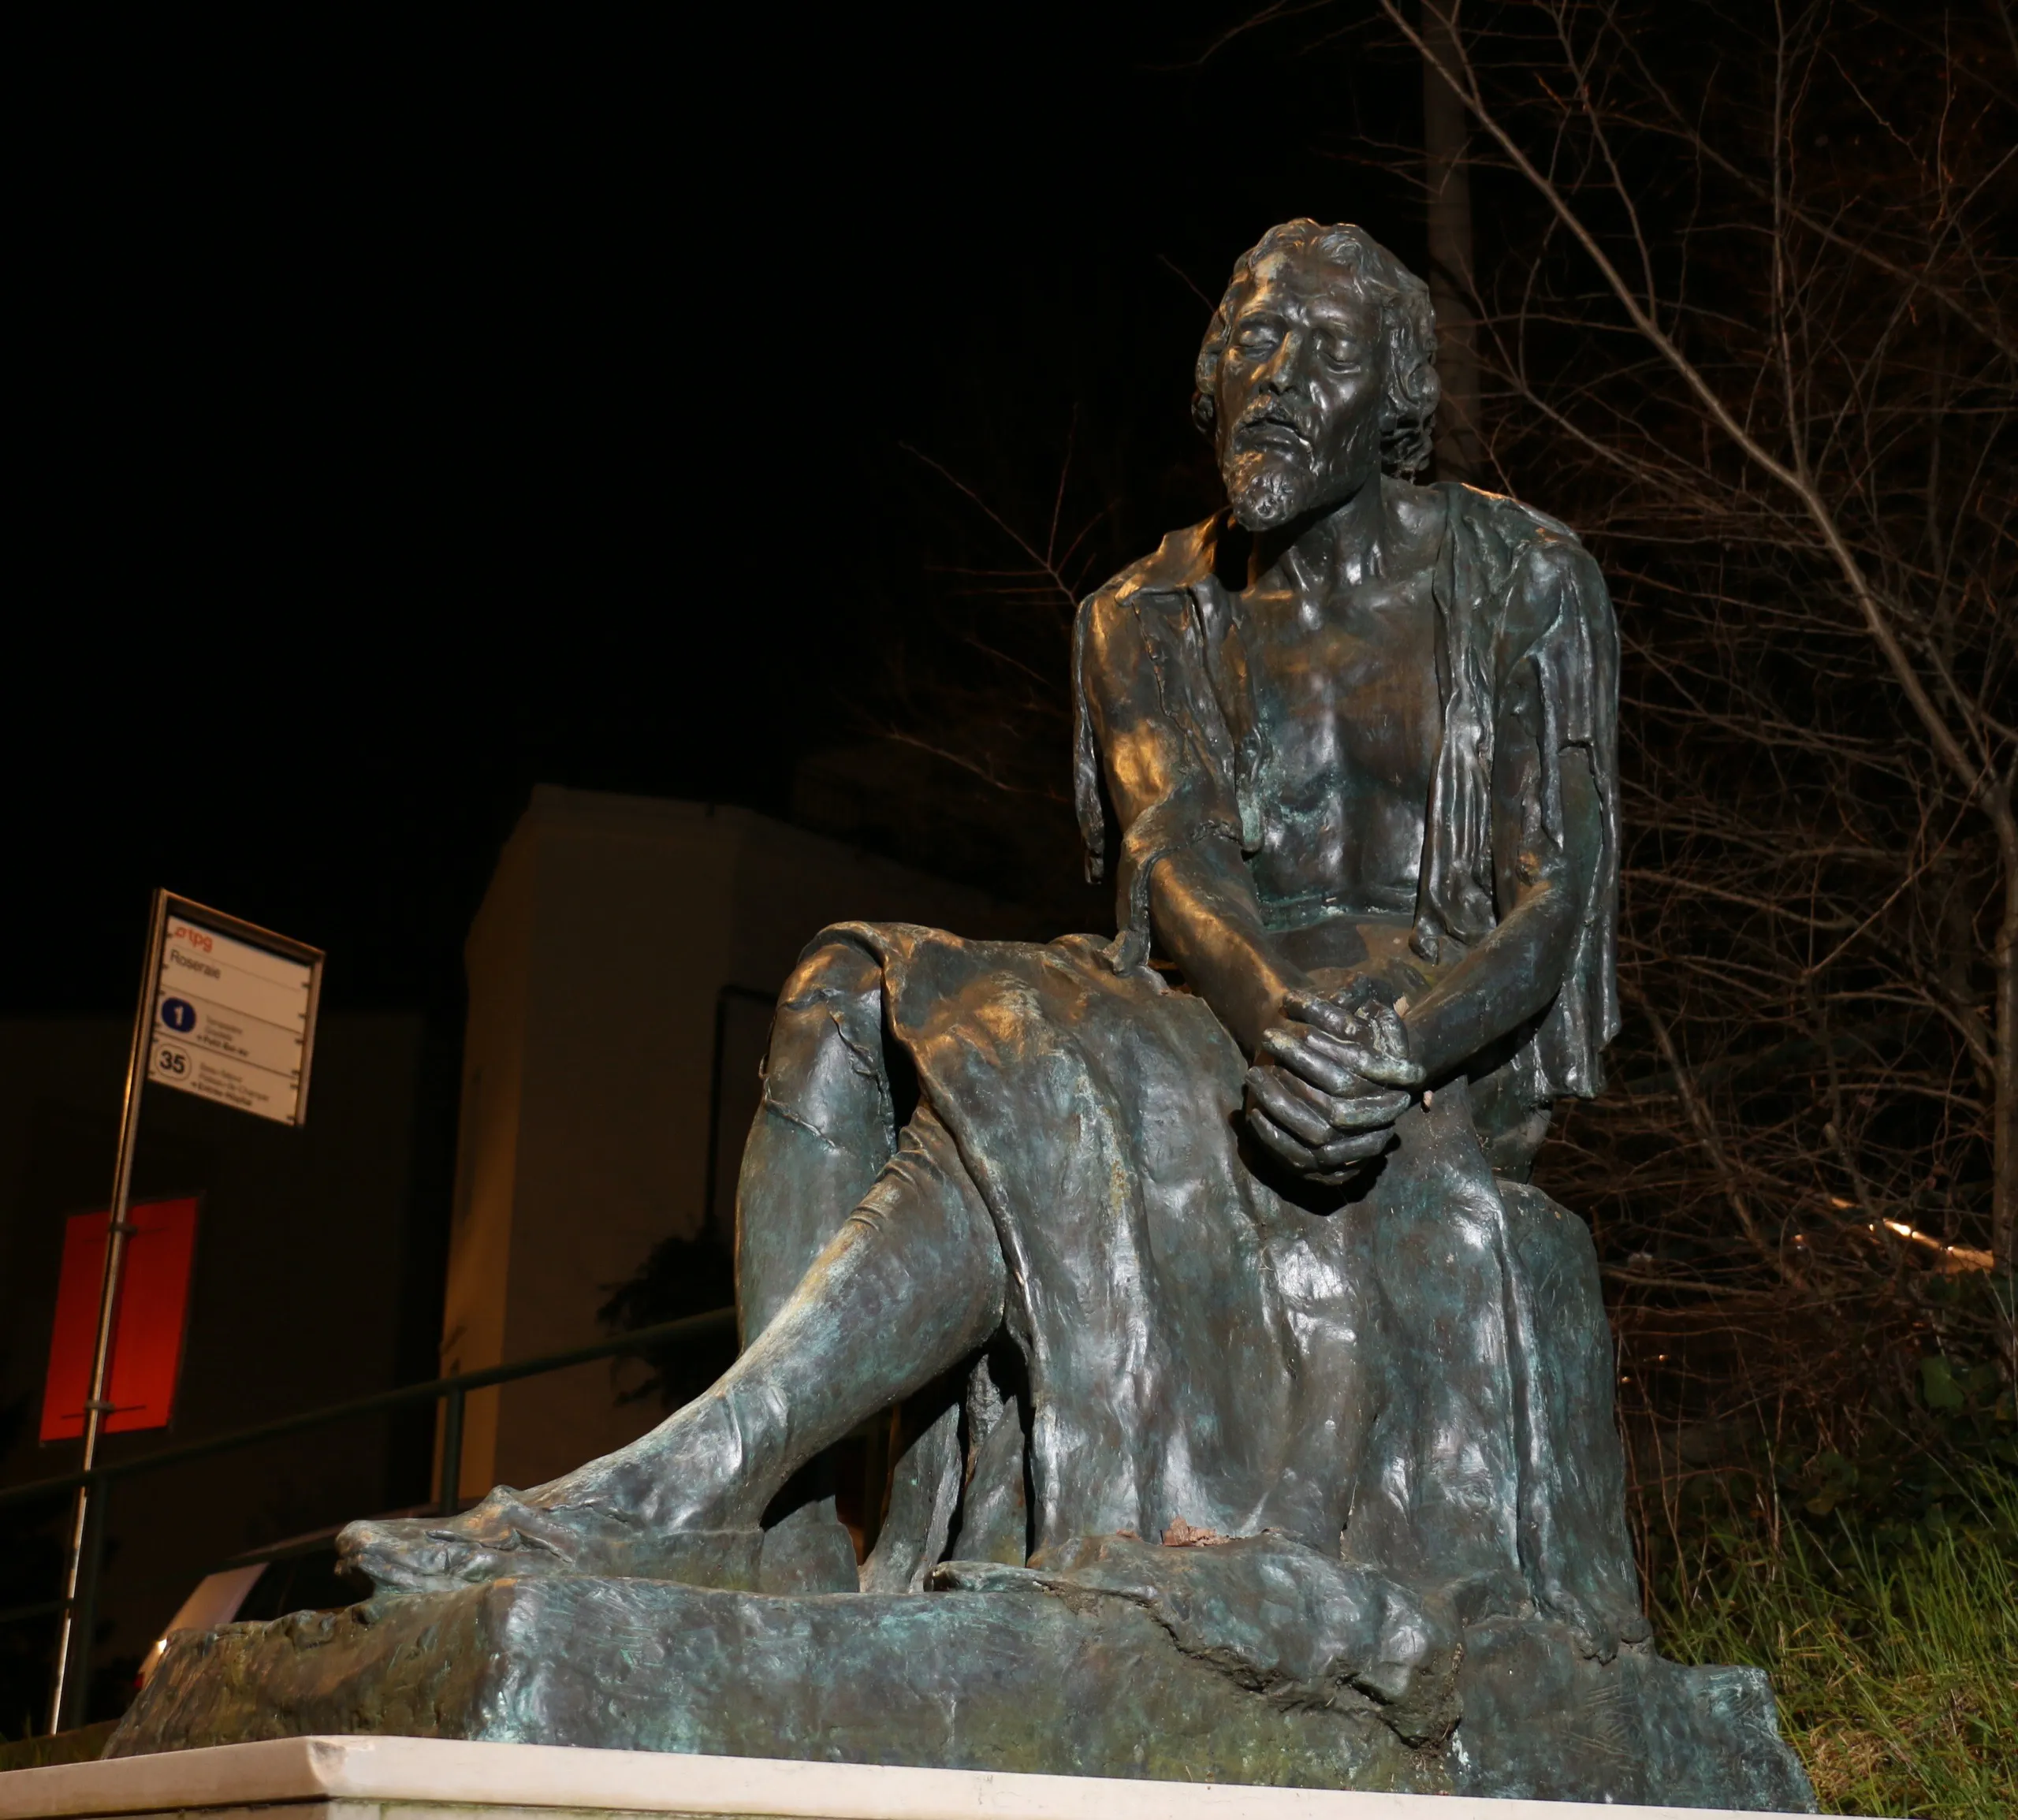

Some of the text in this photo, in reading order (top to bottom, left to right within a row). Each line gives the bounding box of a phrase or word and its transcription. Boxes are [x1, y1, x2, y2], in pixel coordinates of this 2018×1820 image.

[170, 948, 222, 979] Roseraie
[174, 1006, 184, 1026] 1
[160, 1050, 186, 1074] 35
